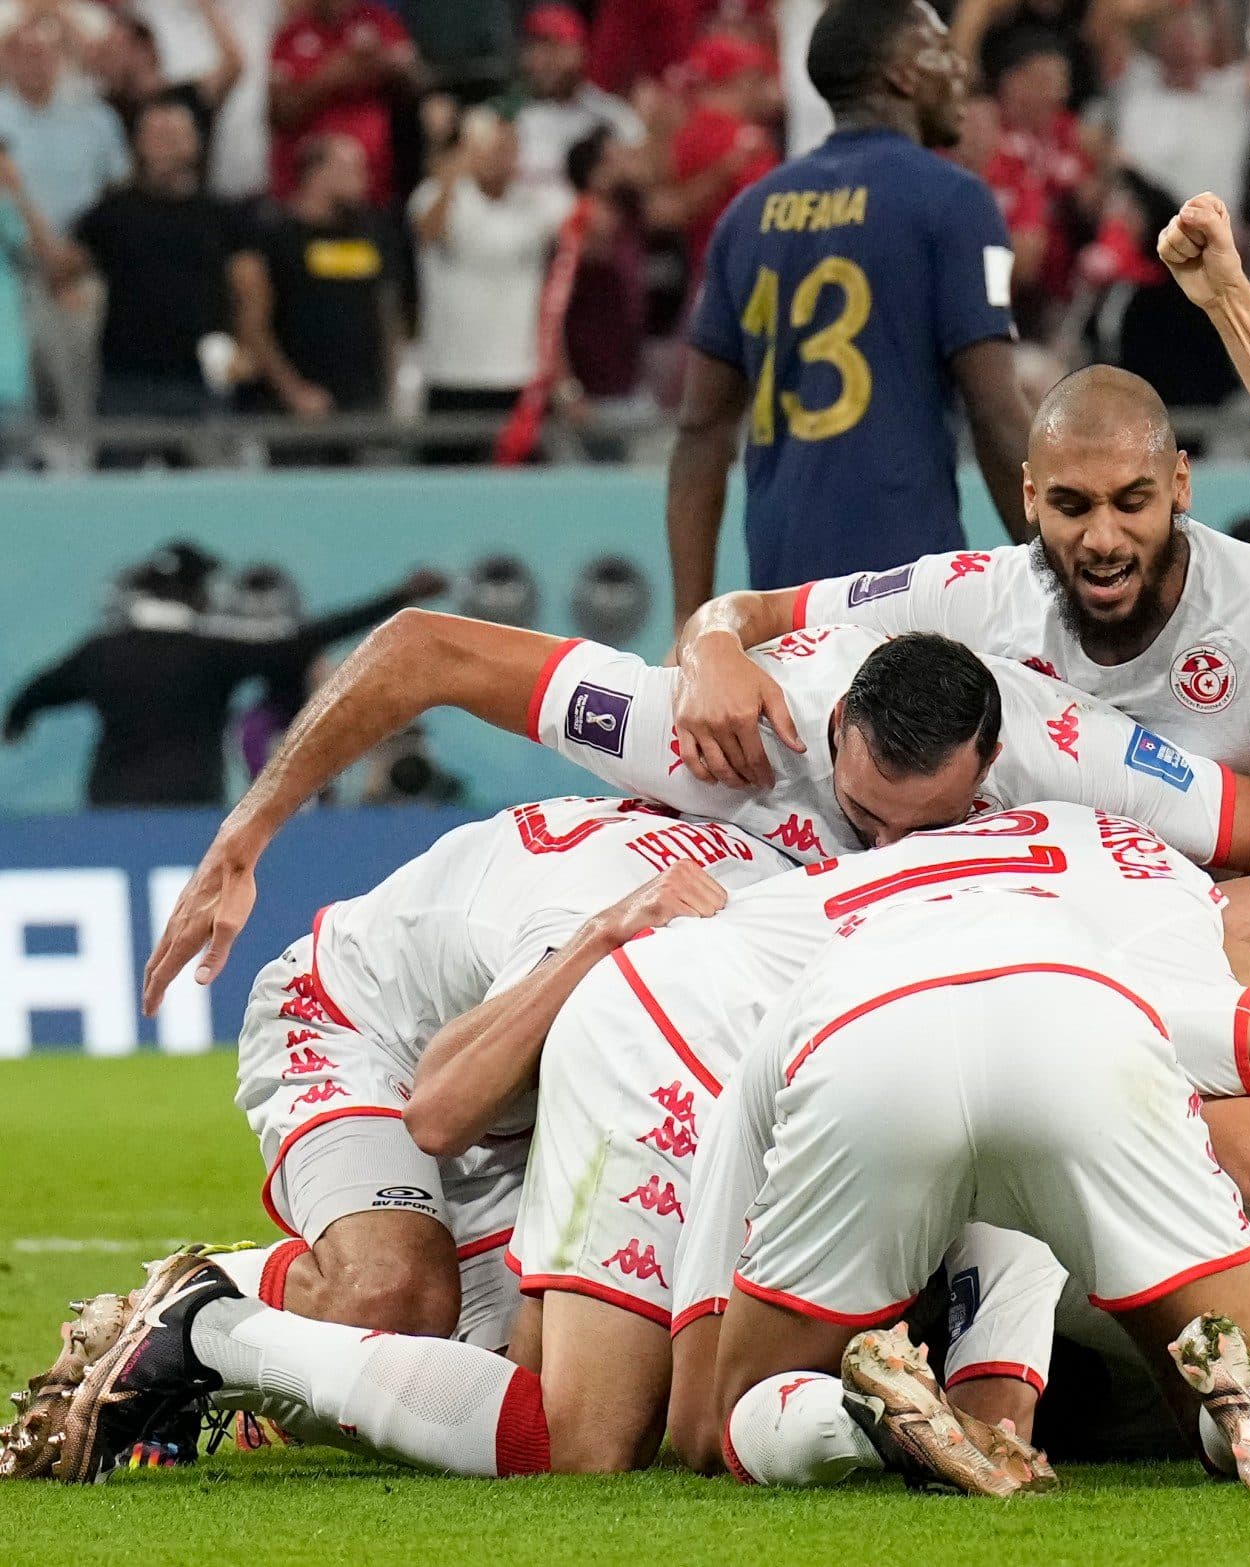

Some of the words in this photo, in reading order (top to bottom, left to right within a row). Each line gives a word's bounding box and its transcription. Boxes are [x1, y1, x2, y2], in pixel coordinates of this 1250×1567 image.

[760, 187, 868, 234] FOFANA
[740, 257, 874, 446] 13
[393, 1200, 438, 1215] SPORT
